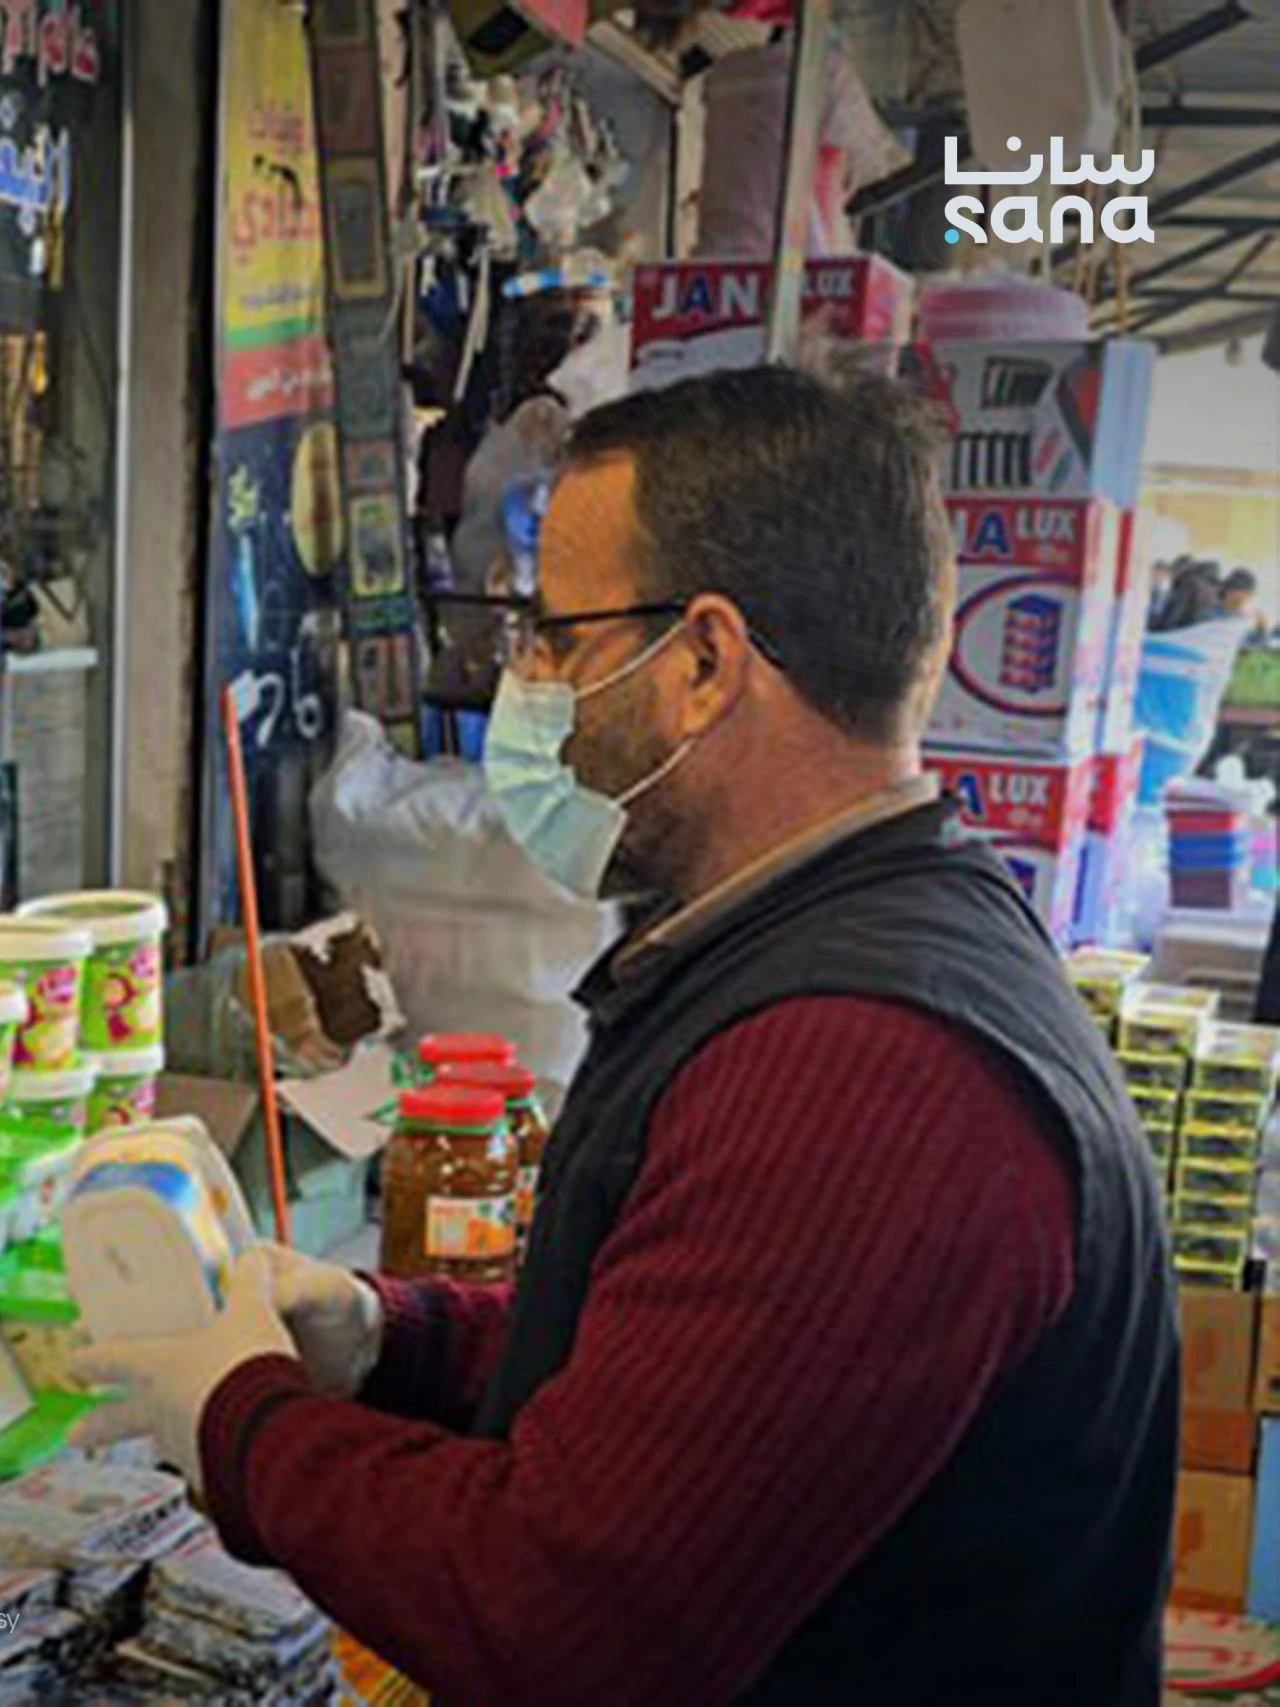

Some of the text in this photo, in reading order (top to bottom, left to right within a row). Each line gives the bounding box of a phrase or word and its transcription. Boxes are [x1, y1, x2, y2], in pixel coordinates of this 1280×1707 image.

[651, 272, 762, 321] JAN
[1016, 508, 1075, 541] LUX
[987, 772, 1051, 803] LUX
